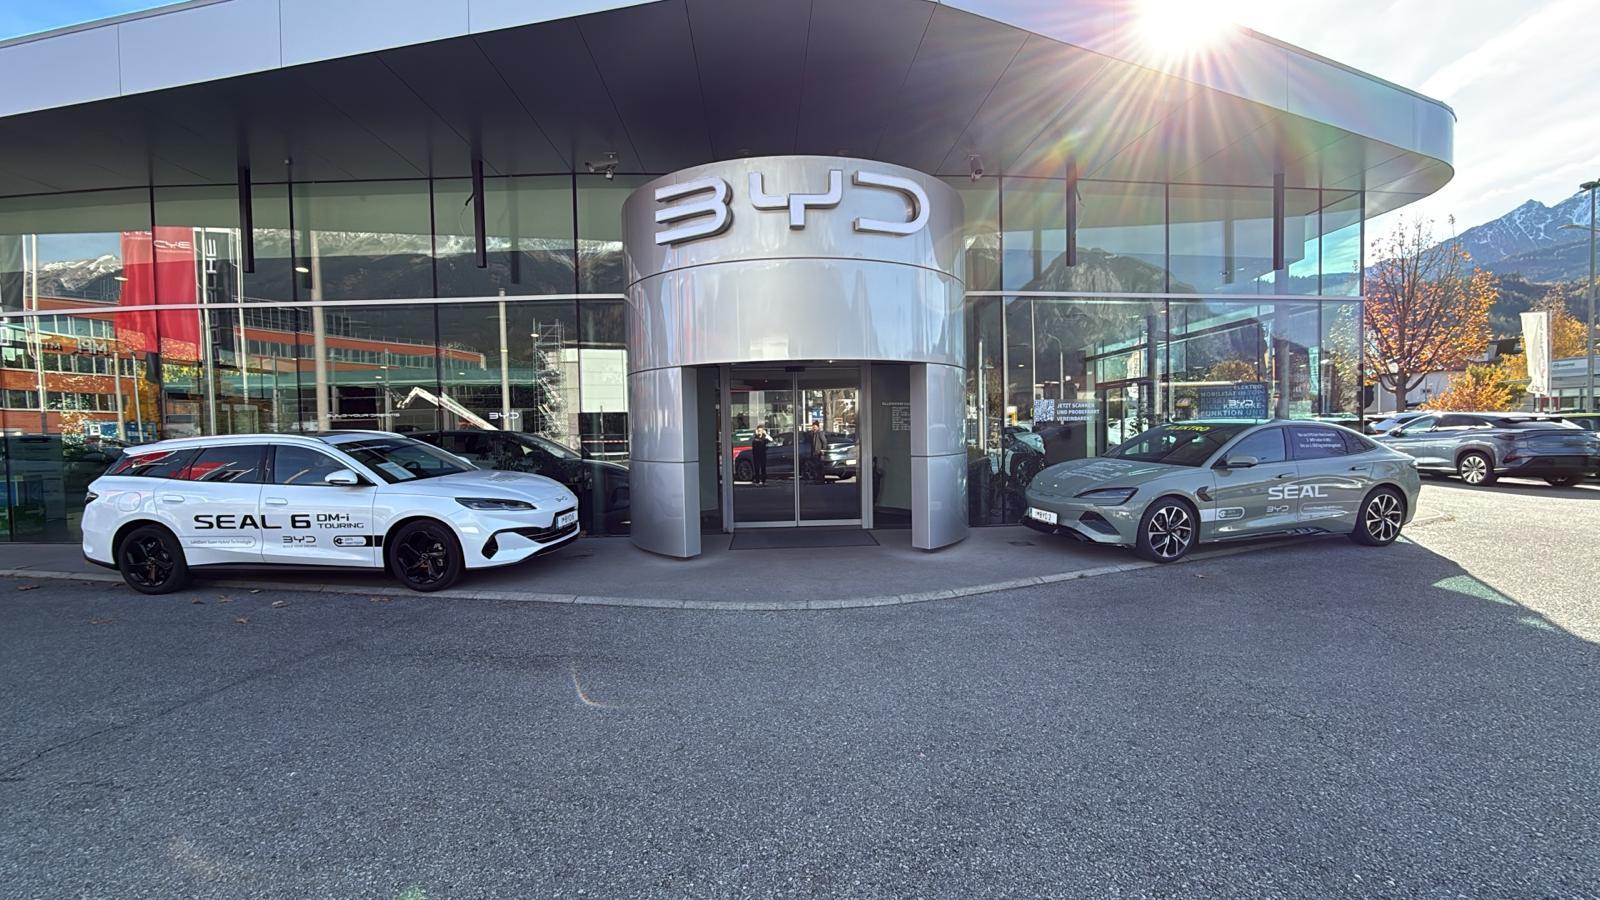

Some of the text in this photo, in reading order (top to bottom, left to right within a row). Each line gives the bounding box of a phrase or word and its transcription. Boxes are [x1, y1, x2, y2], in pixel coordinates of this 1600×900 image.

[655, 169, 930, 246] BYD
[489, 411, 520, 420] BYD
[1267, 485, 1328, 500] SEAL
[1266, 505, 1289, 513] BYD
[193, 514, 311, 529] SEAL 6
[316, 513, 350, 522] DM-i
[282, 535, 317, 544] BYD
